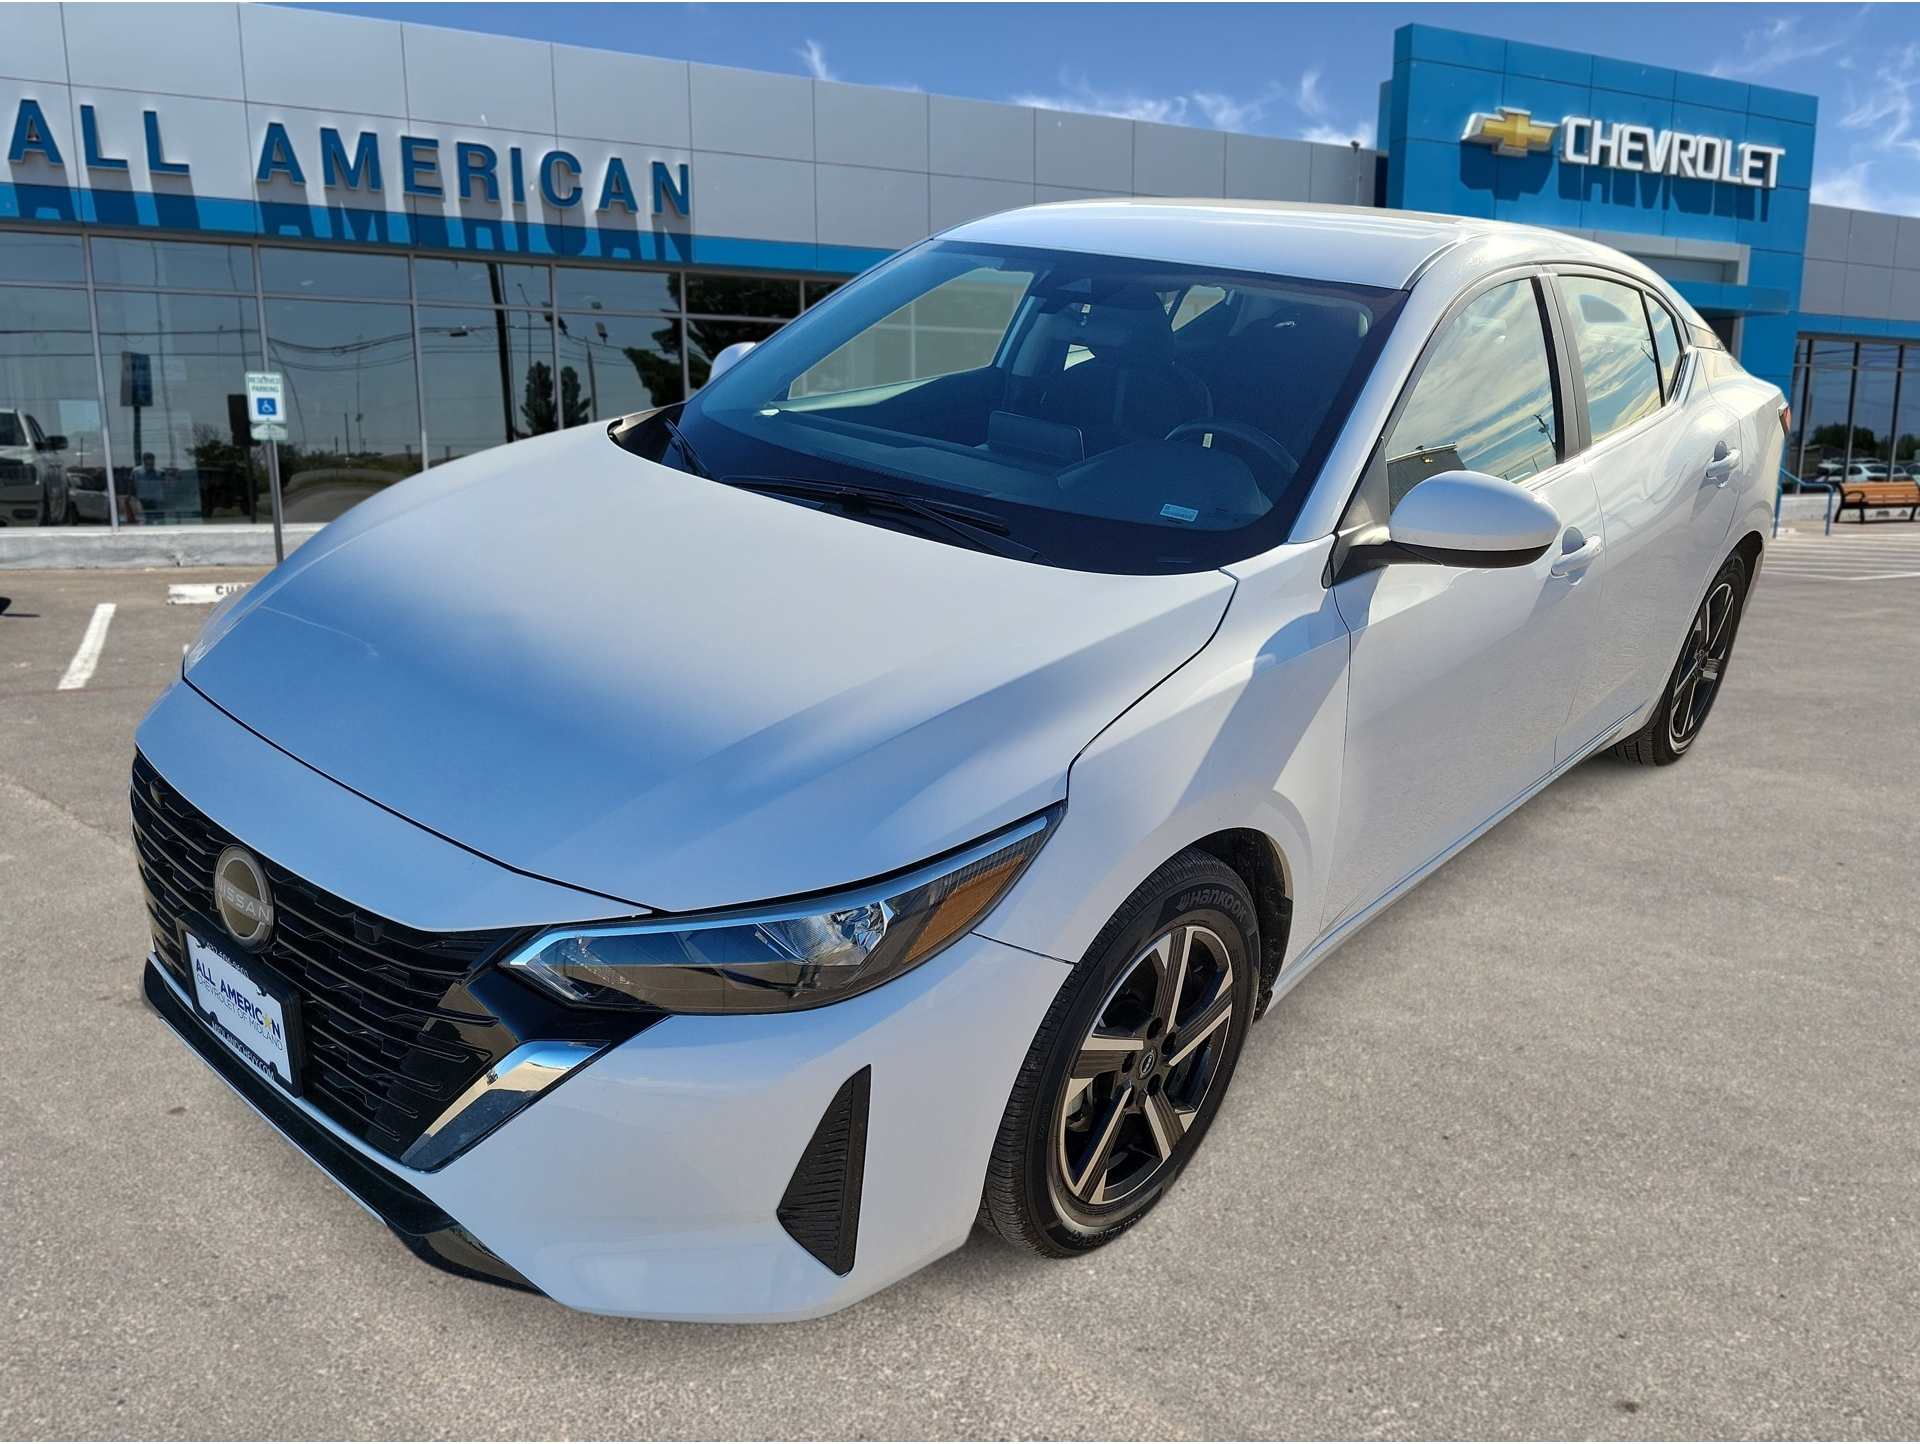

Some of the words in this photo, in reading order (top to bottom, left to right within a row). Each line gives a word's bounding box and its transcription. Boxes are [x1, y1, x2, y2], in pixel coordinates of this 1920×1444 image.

[8, 99, 190, 174] ALL
[257, 122, 690, 217] AMERICAN
[1562, 116, 1786, 188] CHEVROLET
[196, 958, 216, 987] ALL
[197, 973, 236, 1013] CHEVROLET
